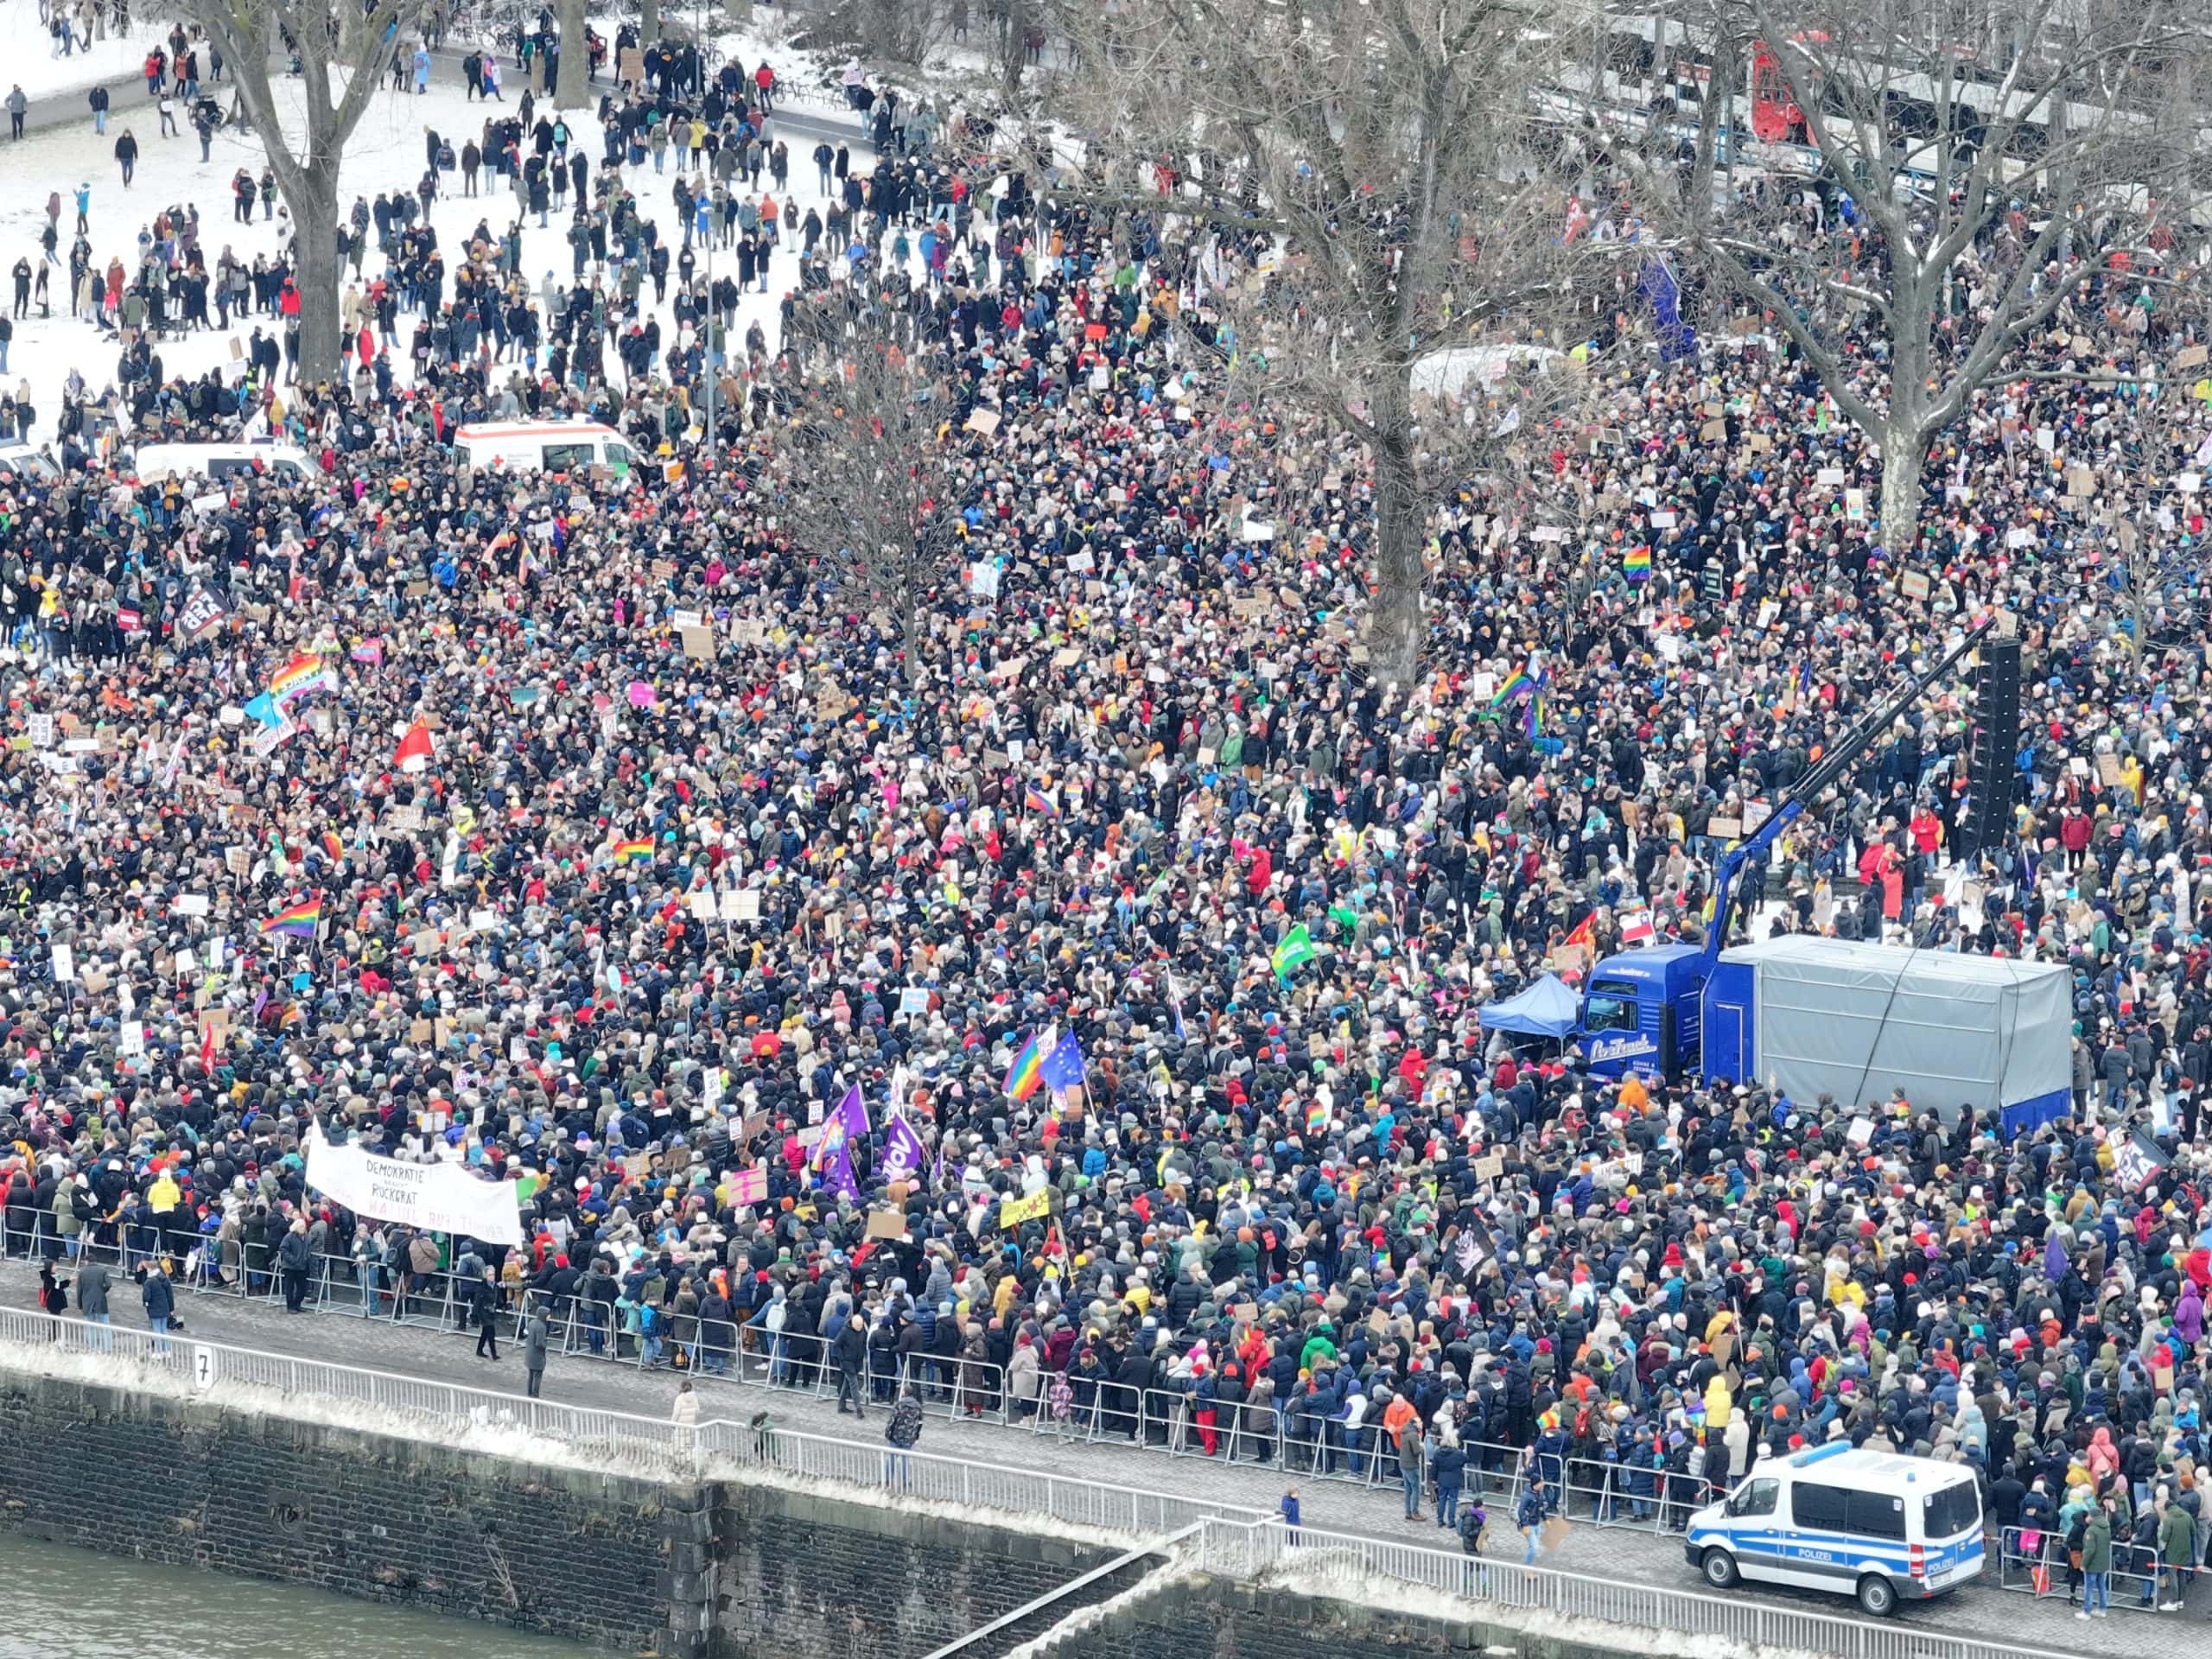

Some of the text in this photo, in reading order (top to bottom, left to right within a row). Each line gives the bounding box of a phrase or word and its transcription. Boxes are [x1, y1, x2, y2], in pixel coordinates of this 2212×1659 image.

[366, 1159, 425, 1184] DEMOKRATIE
[198, 1354, 208, 1382] 7
[1798, 1548, 1832, 1562] POLIZEI
[1928, 1557, 1955, 1573] POLIZEI
